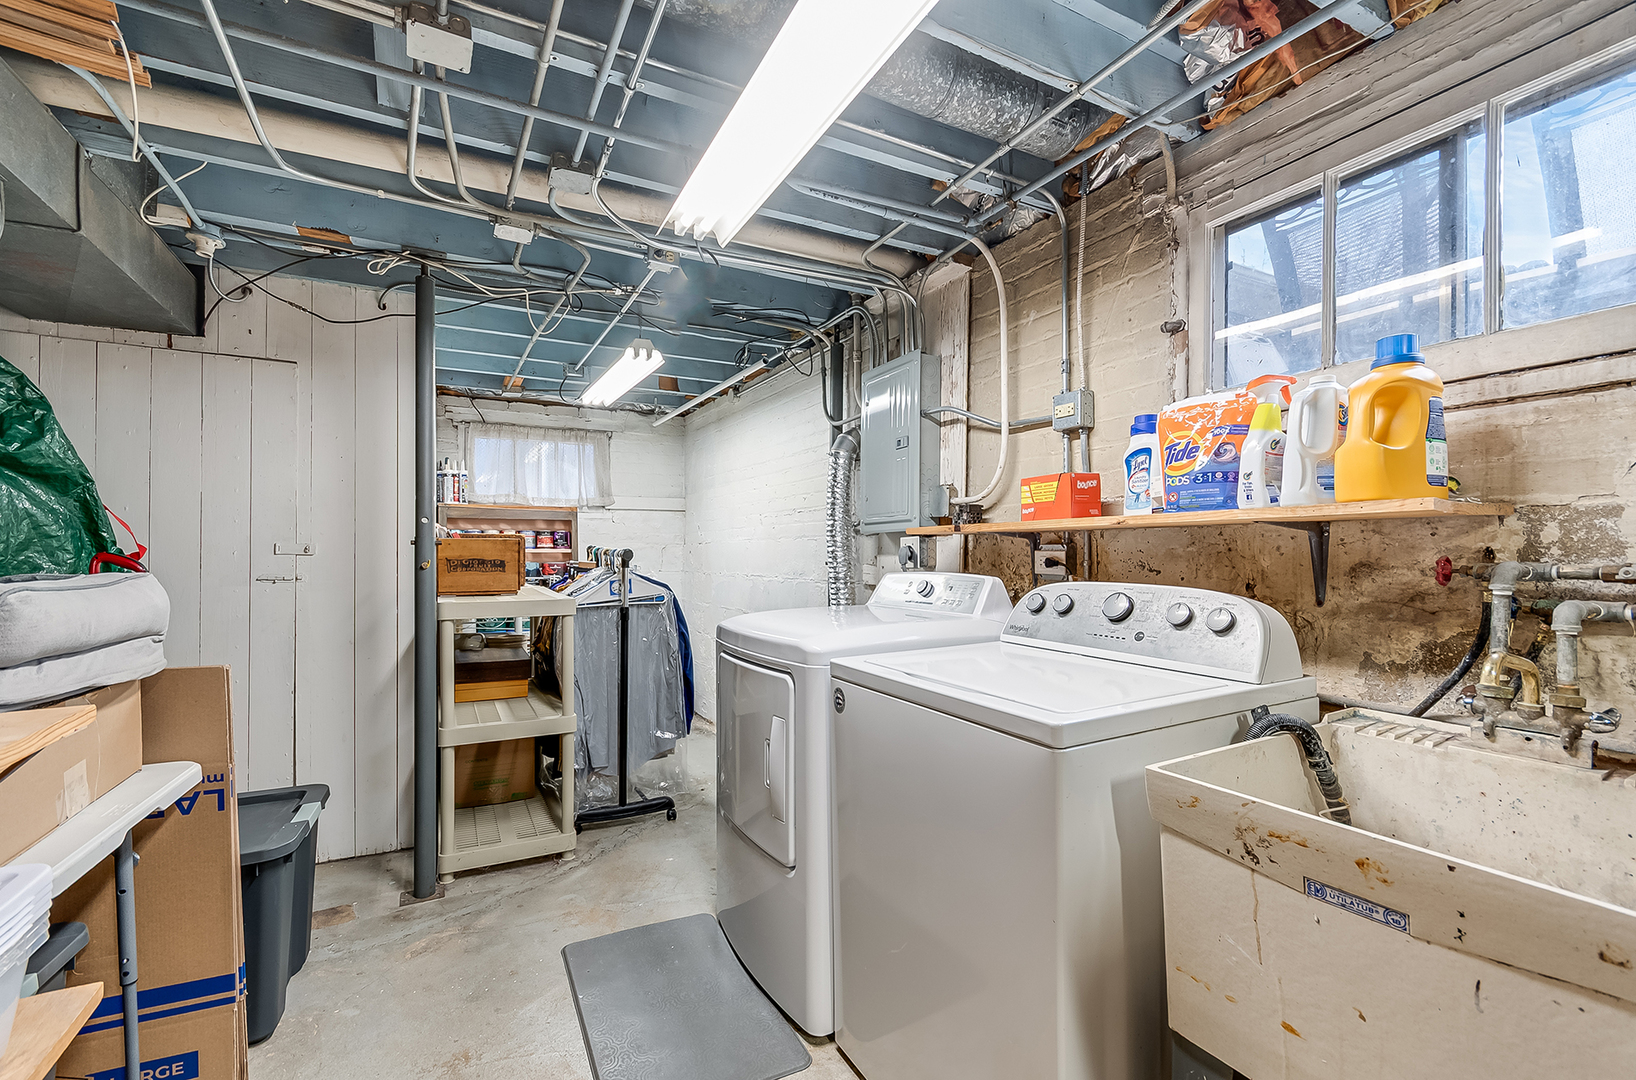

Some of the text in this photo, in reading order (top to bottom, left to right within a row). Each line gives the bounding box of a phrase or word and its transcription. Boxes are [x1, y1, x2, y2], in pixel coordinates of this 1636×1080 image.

[1164, 441, 1200, 468] Tide
[1132, 457, 1148, 472] Lysol
[1077, 480, 1097, 489] bounce
[1165, 475, 1190, 486] PODS
[1009, 624, 1030, 633] Whirlpool
